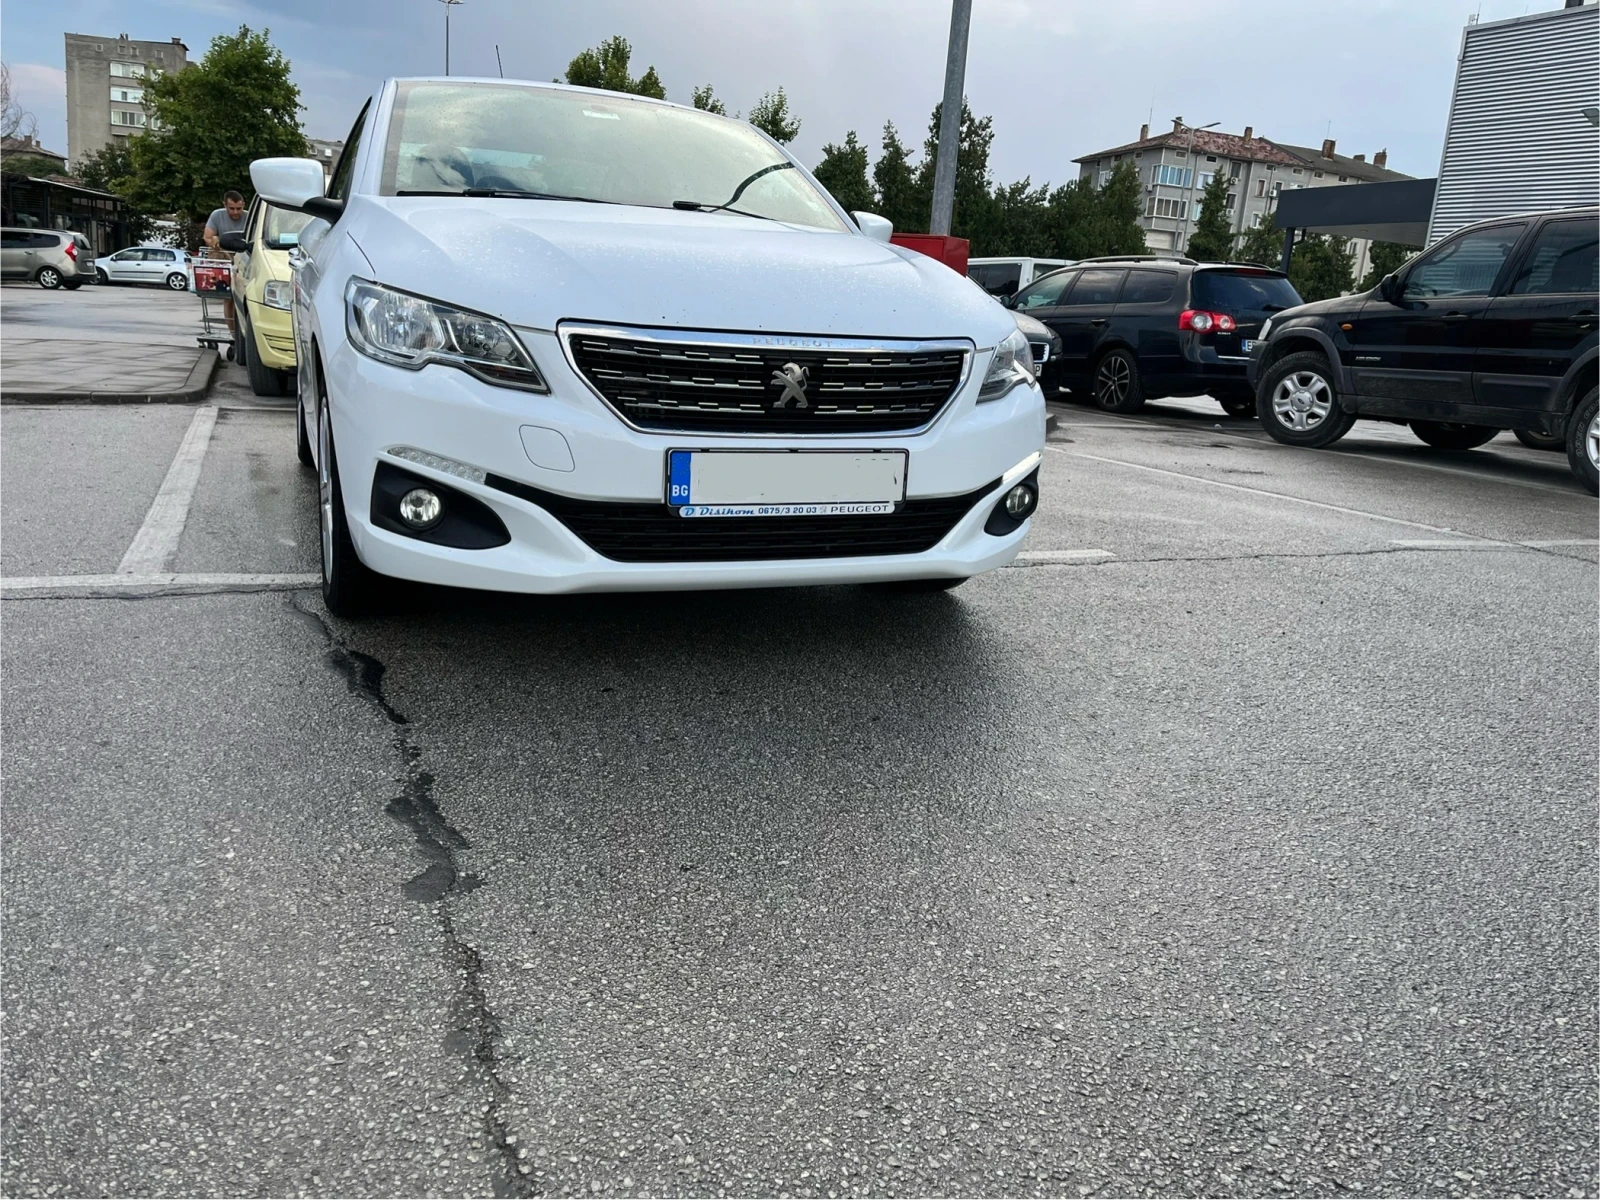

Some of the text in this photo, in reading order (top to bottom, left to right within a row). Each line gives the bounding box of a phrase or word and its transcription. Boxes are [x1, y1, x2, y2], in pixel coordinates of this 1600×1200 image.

[753, 337, 832, 347] PEUGEOT
[672, 484, 689, 497] BG
[758, 506, 791, 515] 0675/3
[792, 506, 804, 514] 20
[806, 506, 817, 514] 03
[830, 505, 889, 514] PEUGEOT
